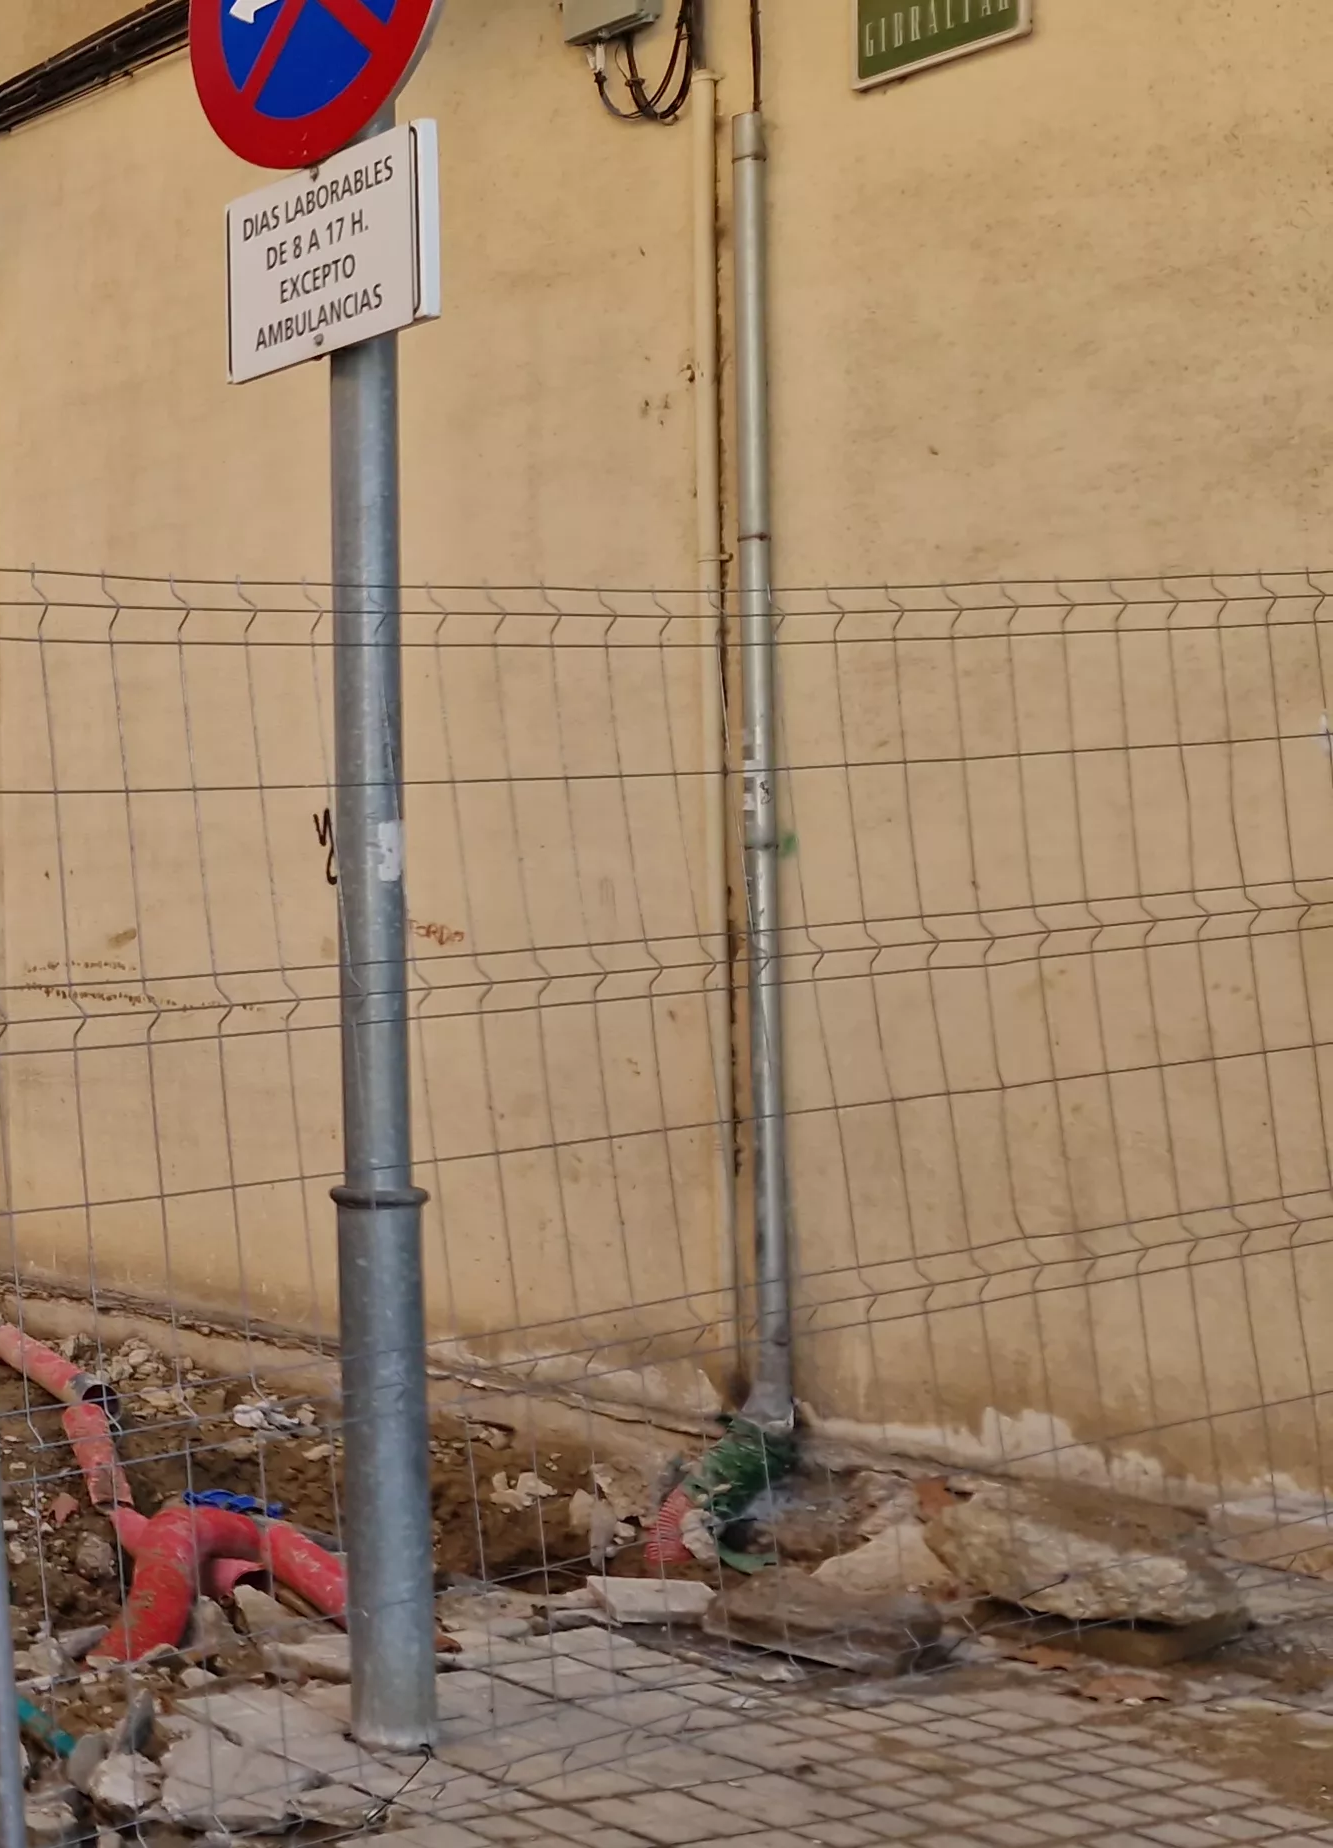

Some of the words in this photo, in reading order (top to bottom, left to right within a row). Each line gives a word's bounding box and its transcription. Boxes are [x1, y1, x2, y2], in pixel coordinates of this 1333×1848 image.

[864, 0, 1010, 57] GIBRALT
[242, 205, 280, 242] DIAS
[284, 155, 394, 224] LABORABLES
[266, 241, 288, 271] DE
[292, 235, 303, 260] 8
[307, 228, 321, 254] A
[326, 217, 345, 245] 17
[351, 208, 369, 236] H.
[280, 253, 356, 304] EXCEPTO
[255, 283, 383, 351] AMBULANCIAS
